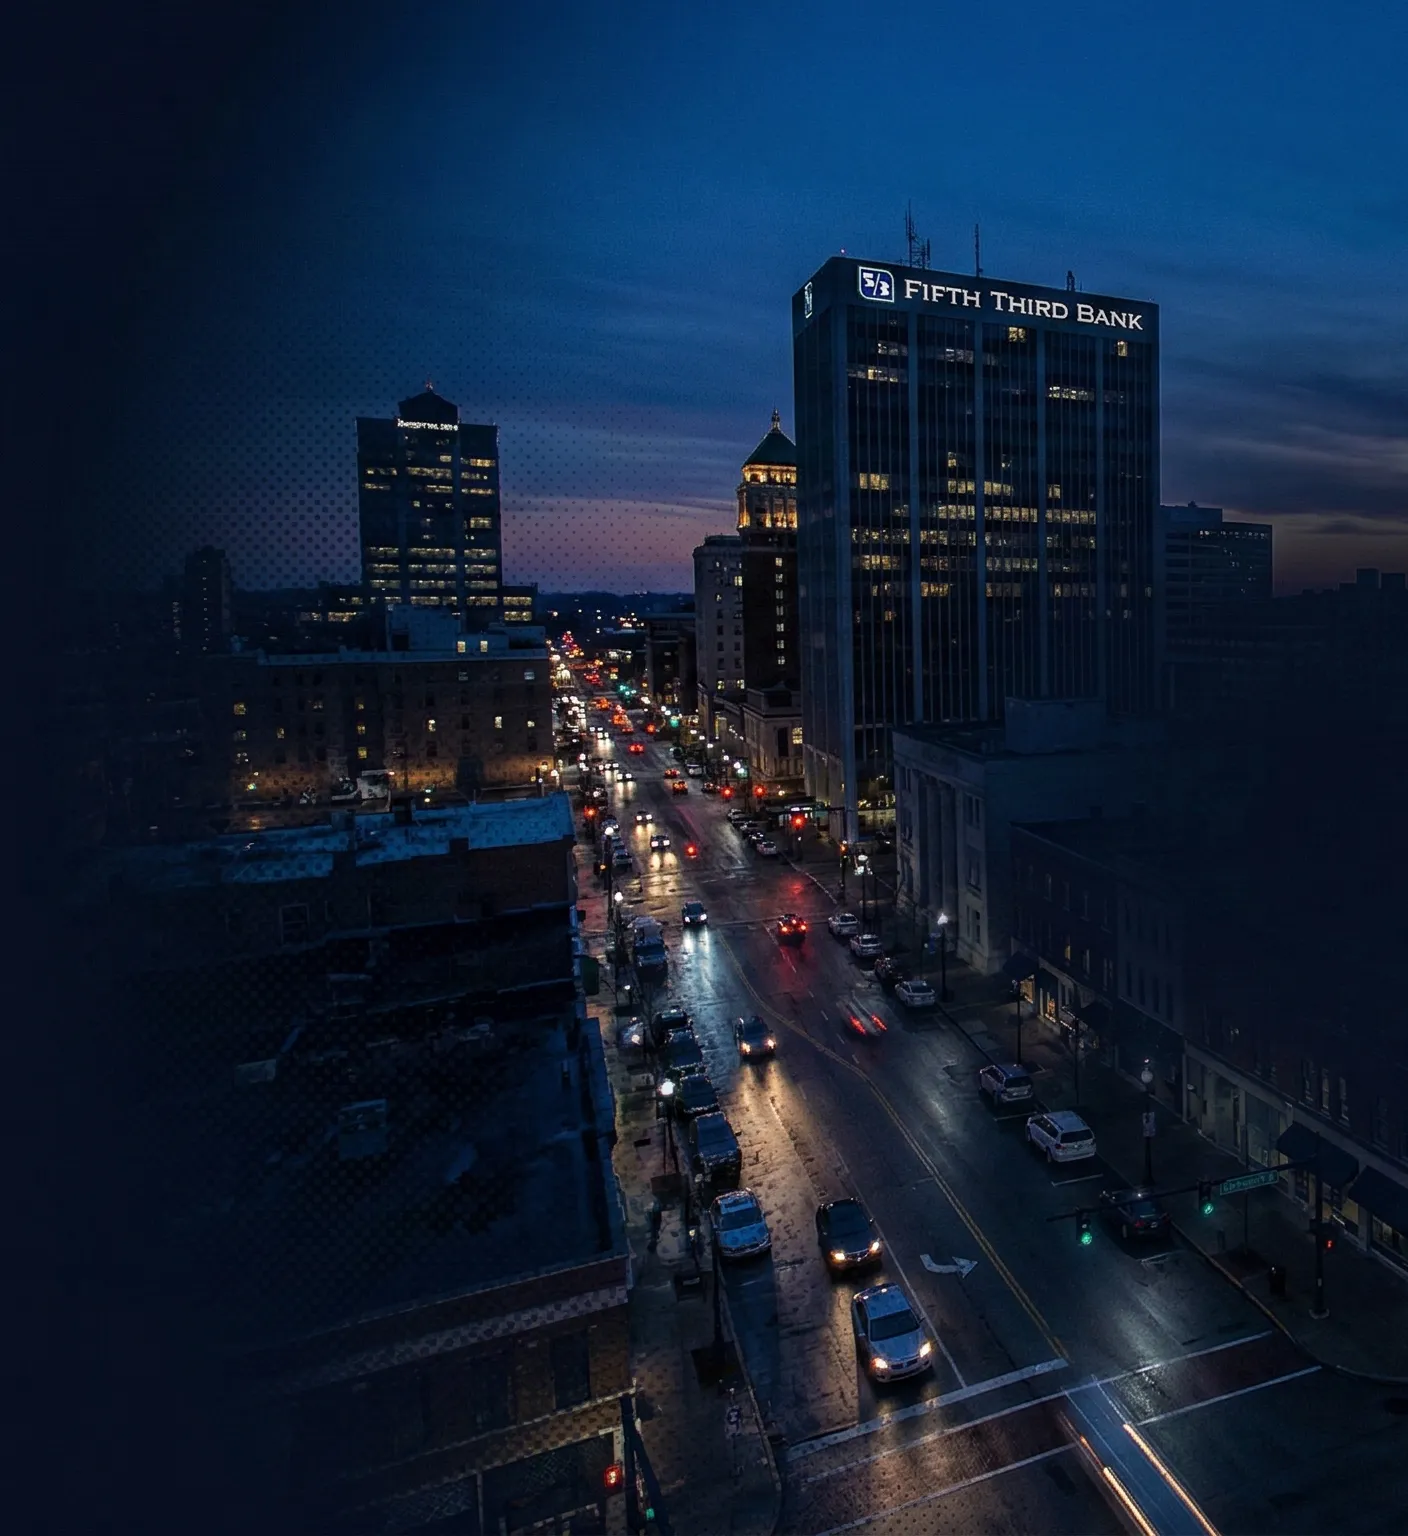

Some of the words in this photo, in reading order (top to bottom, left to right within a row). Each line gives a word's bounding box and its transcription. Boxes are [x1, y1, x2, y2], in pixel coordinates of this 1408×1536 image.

[904, 278, 982, 308] FIFTH
[990, 290, 1069, 320] THIRD
[1076, 302, 1144, 331] BANK
